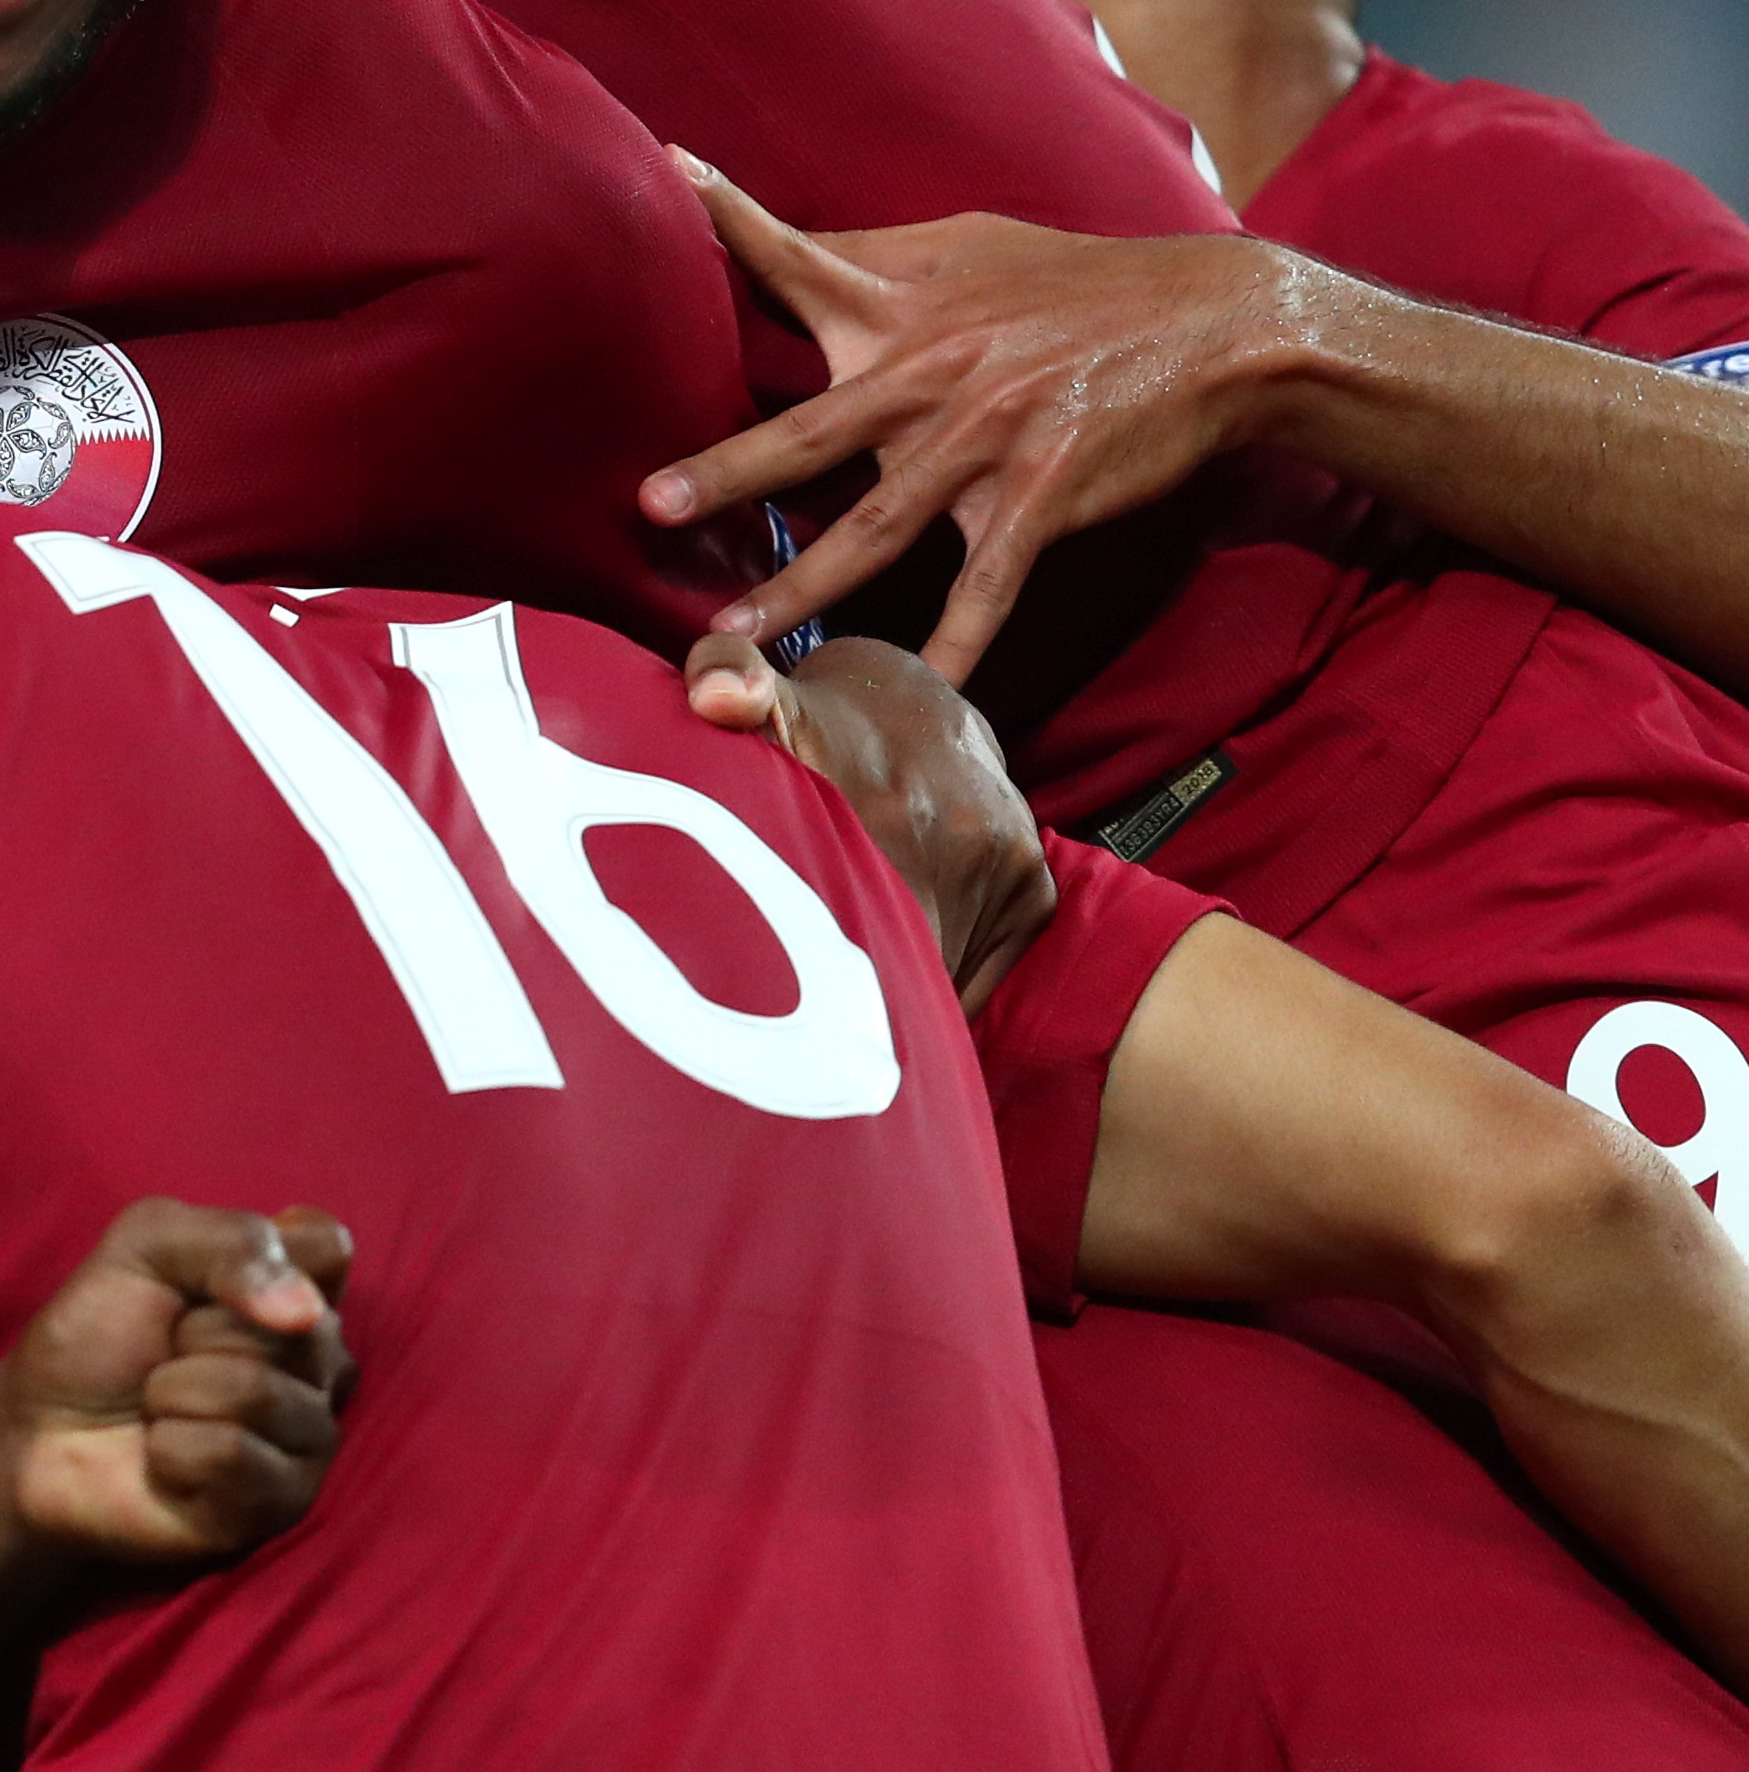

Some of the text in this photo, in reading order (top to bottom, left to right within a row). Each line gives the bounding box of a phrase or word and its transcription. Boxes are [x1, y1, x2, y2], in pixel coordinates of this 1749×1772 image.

[14, 529, 902, 1121] 16
[1182, 766, 1215, 796] 2018
[1566, 1000, 1749, 1273] 9
